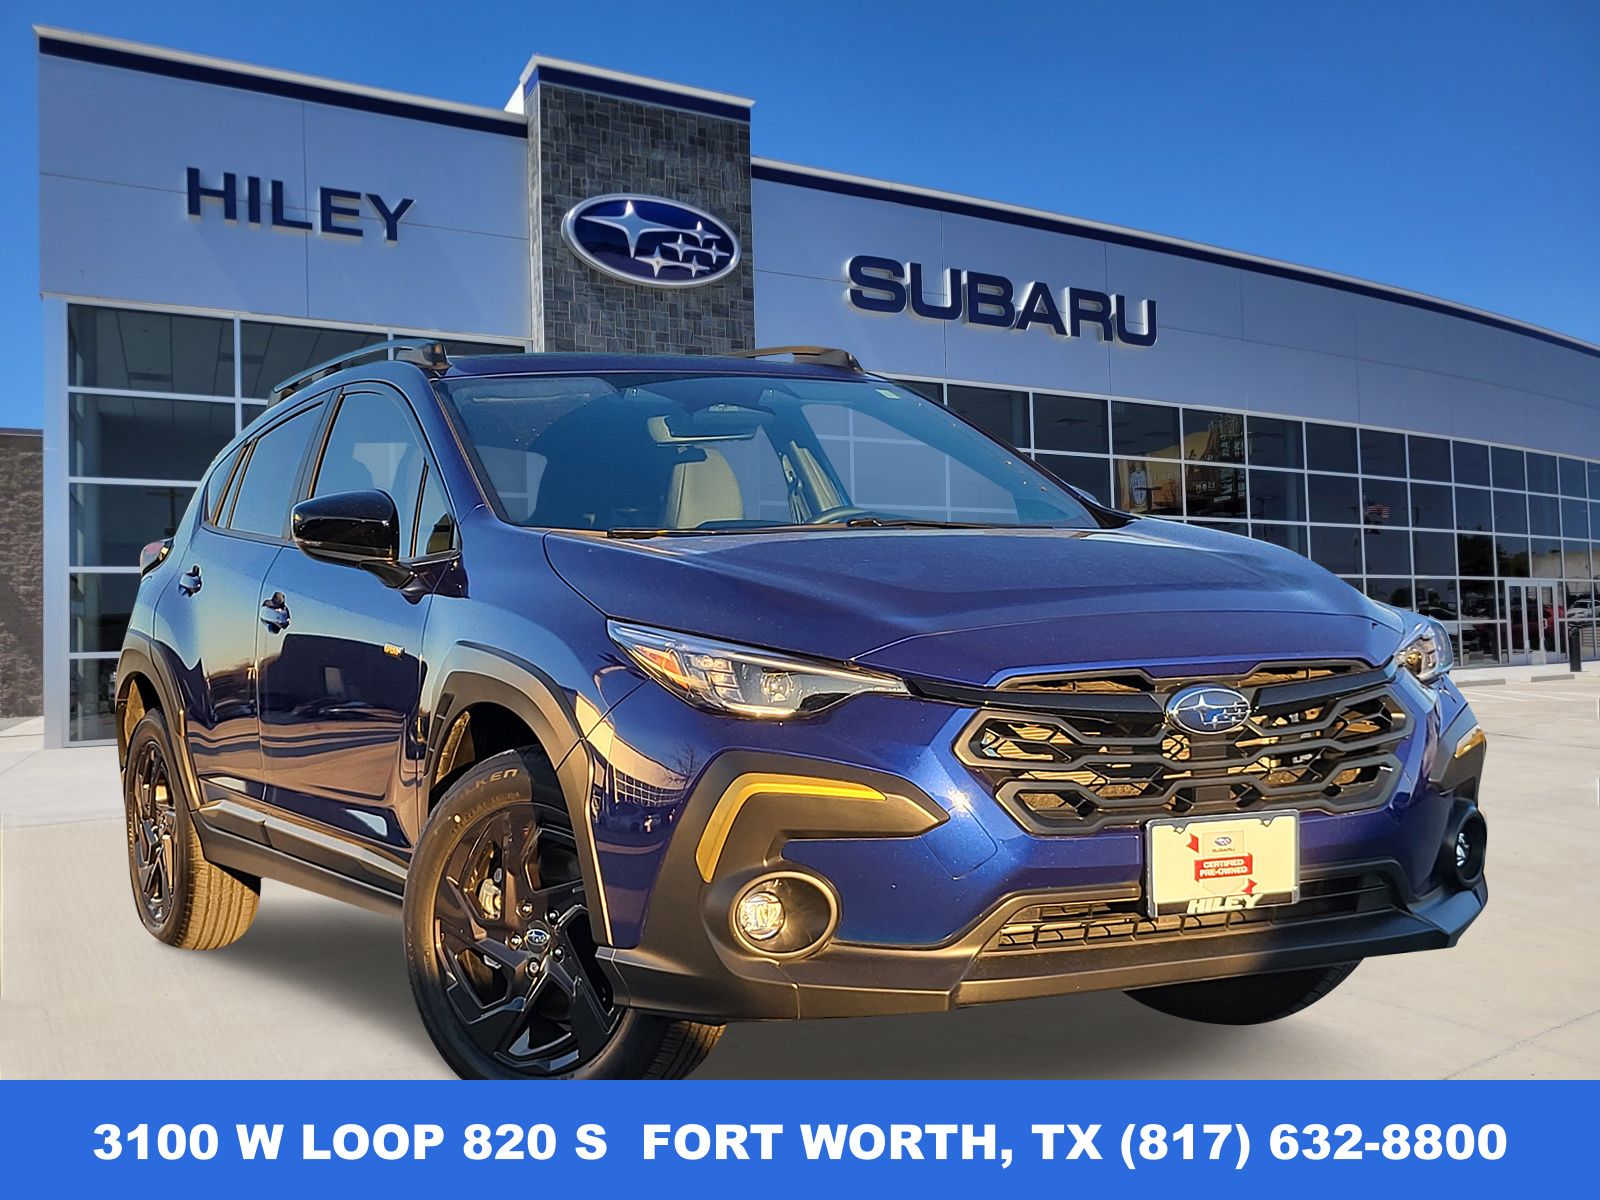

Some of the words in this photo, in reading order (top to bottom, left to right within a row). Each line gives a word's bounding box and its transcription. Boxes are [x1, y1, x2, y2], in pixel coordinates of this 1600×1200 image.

[186, 166, 416, 242] HILEY
[846, 254, 1158, 347] SUBARU
[1199, 865, 1248, 877] PRE-OWNED
[1202, 858, 1244, 869] CERTIFIED
[1186, 893, 1264, 915] HILEY
